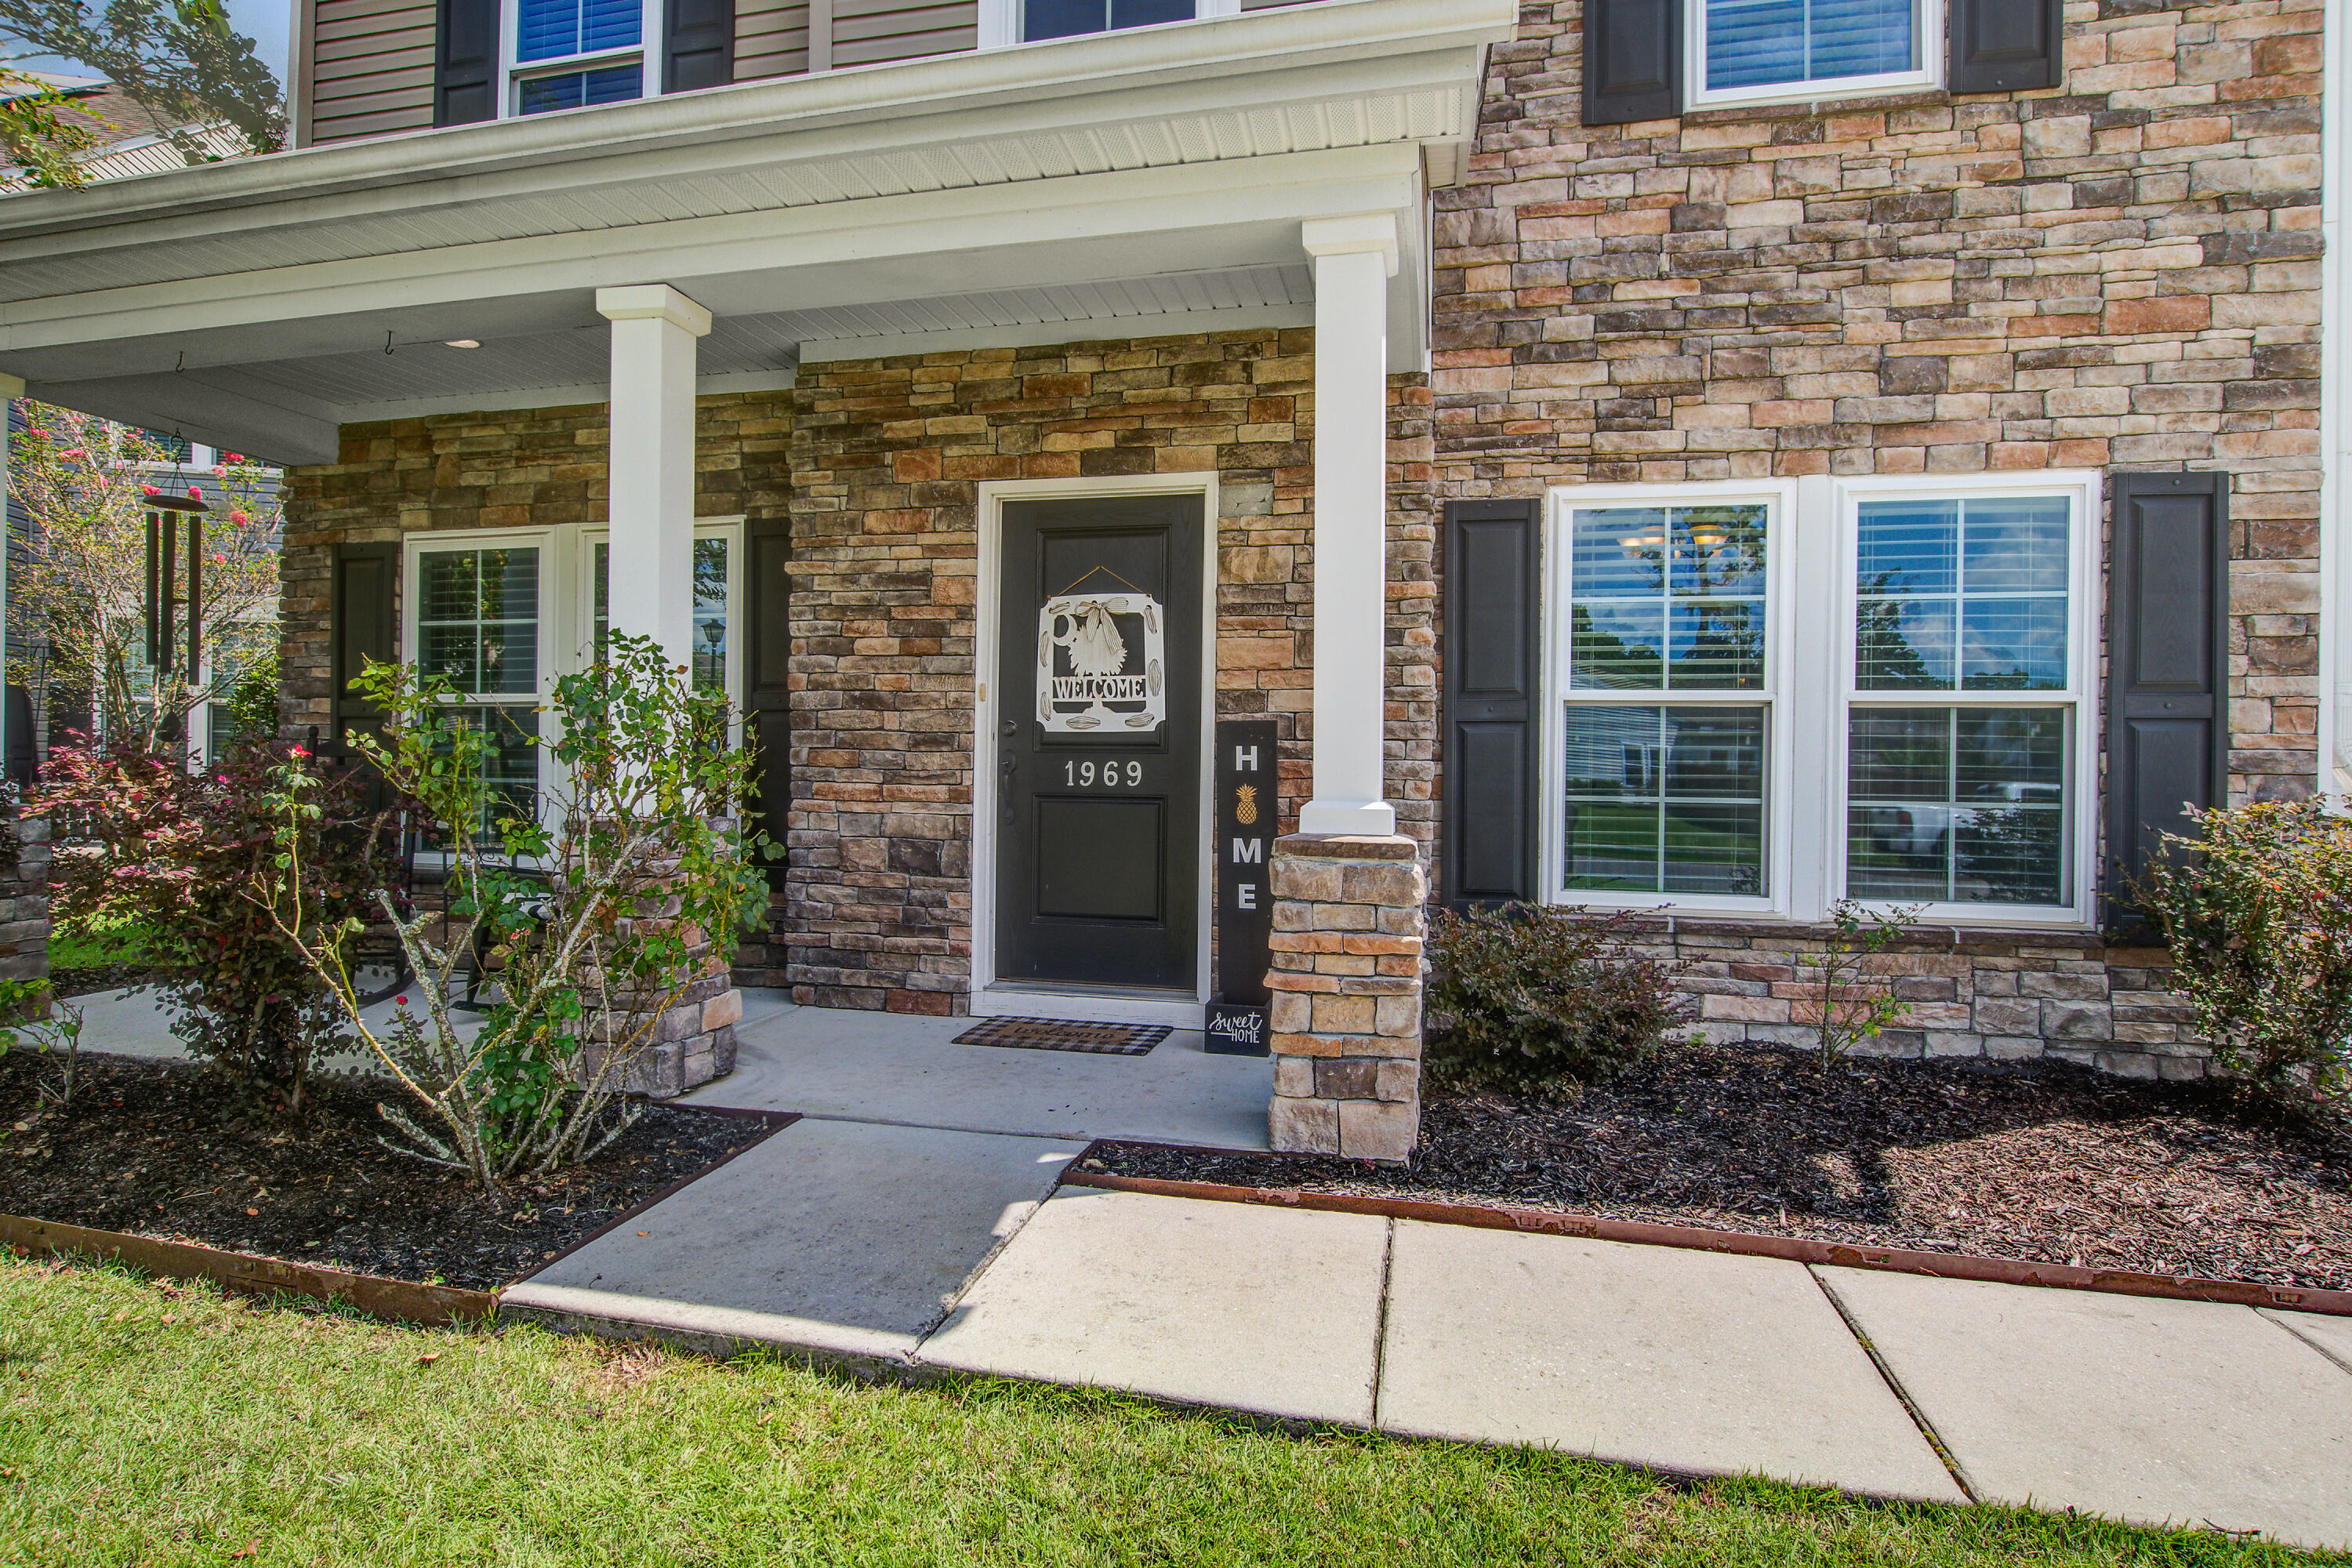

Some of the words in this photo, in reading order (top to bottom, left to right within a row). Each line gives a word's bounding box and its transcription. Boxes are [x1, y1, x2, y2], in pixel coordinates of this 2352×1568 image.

[1053, 676, 1145, 699] WELCOME
[1065, 760, 1142, 786] 1969
[1231, 1029, 1260, 1044] HOME
